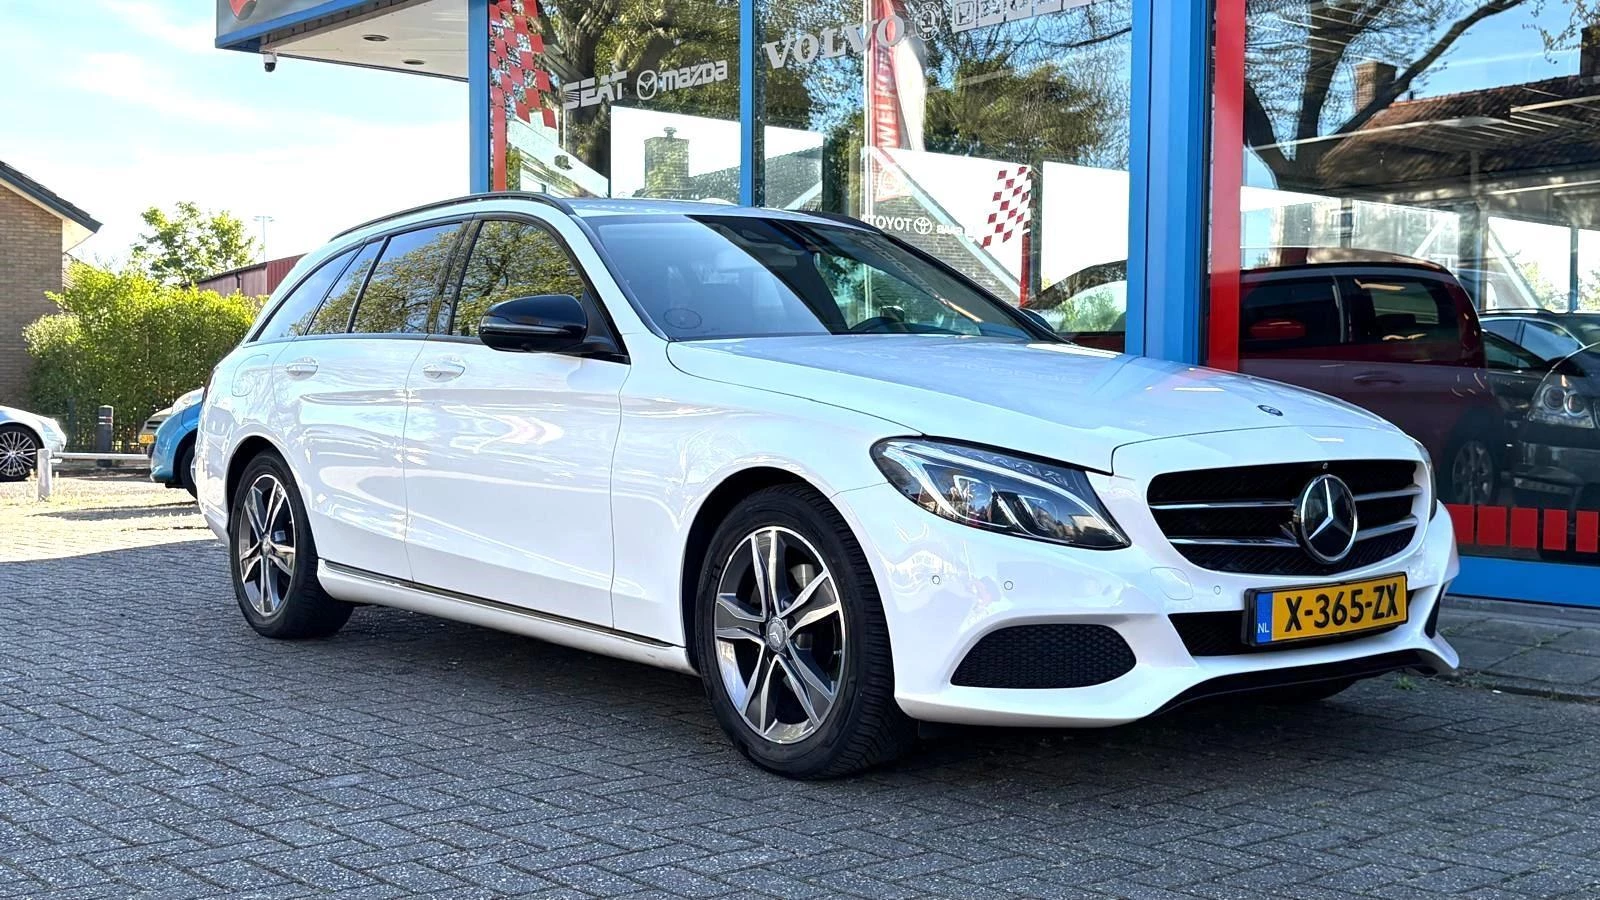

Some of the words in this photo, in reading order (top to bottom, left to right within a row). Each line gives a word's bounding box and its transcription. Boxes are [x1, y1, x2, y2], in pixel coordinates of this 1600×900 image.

[762, 15, 906, 70] VOLVO
[563, 71, 627, 110] SEAT
[874, 48, 897, 149] WELK
[1257, 623, 1270, 634] NL
[1284, 583, 1398, 633] X-365-ZX
